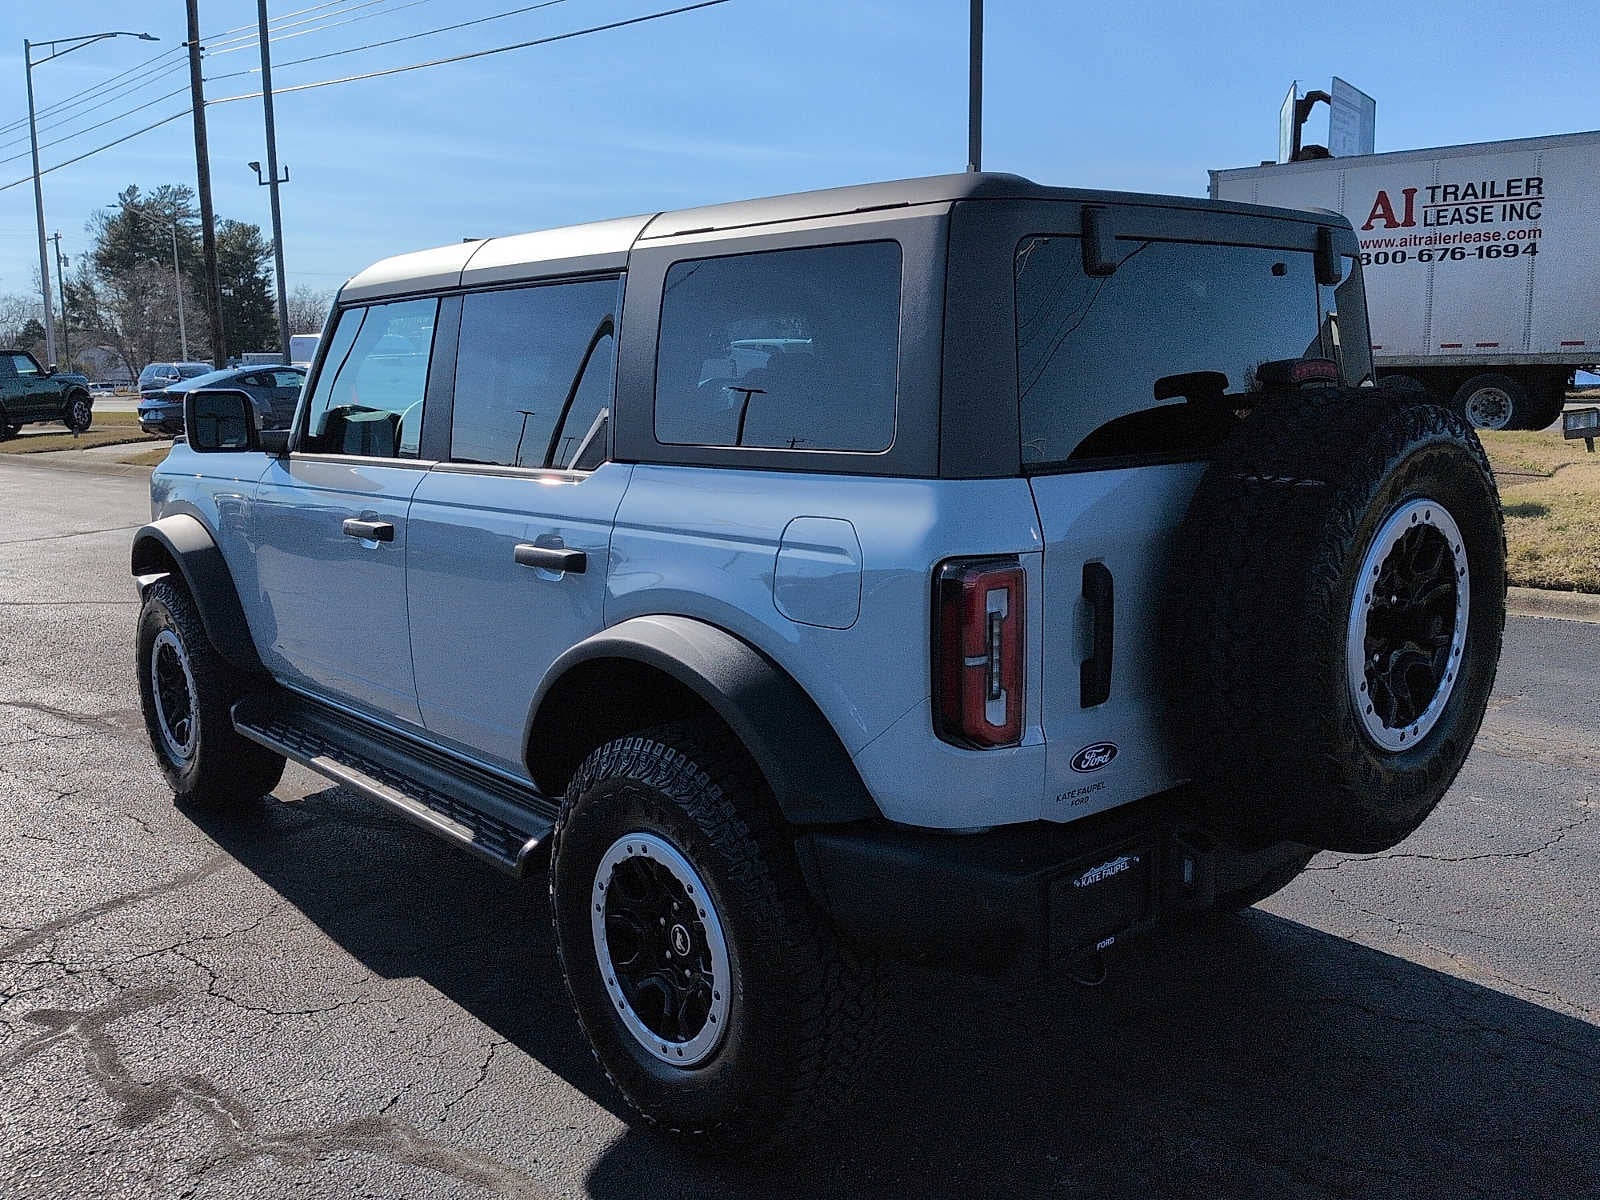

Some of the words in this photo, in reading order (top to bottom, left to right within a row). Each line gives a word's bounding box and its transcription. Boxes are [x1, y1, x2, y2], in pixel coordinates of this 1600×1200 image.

[1425, 176, 1544, 204] TRAILER
[1361, 187, 1418, 231] AI
[1423, 205, 1494, 228] LEASE
[1501, 201, 1543, 222] INC
[1360, 227, 1543, 249] www.aitrailerlease.com
[1081, 747, 1112, 769] Ford
[1056, 790, 1077, 803] KATE
[1076, 782, 1106, 796] FAUPEL
[1071, 796, 1090, 807] FORD
[1081, 872, 1102, 888] KATE
[1102, 862, 1130, 879] FAUPEL
[1096, 936, 1115, 951] FORD
